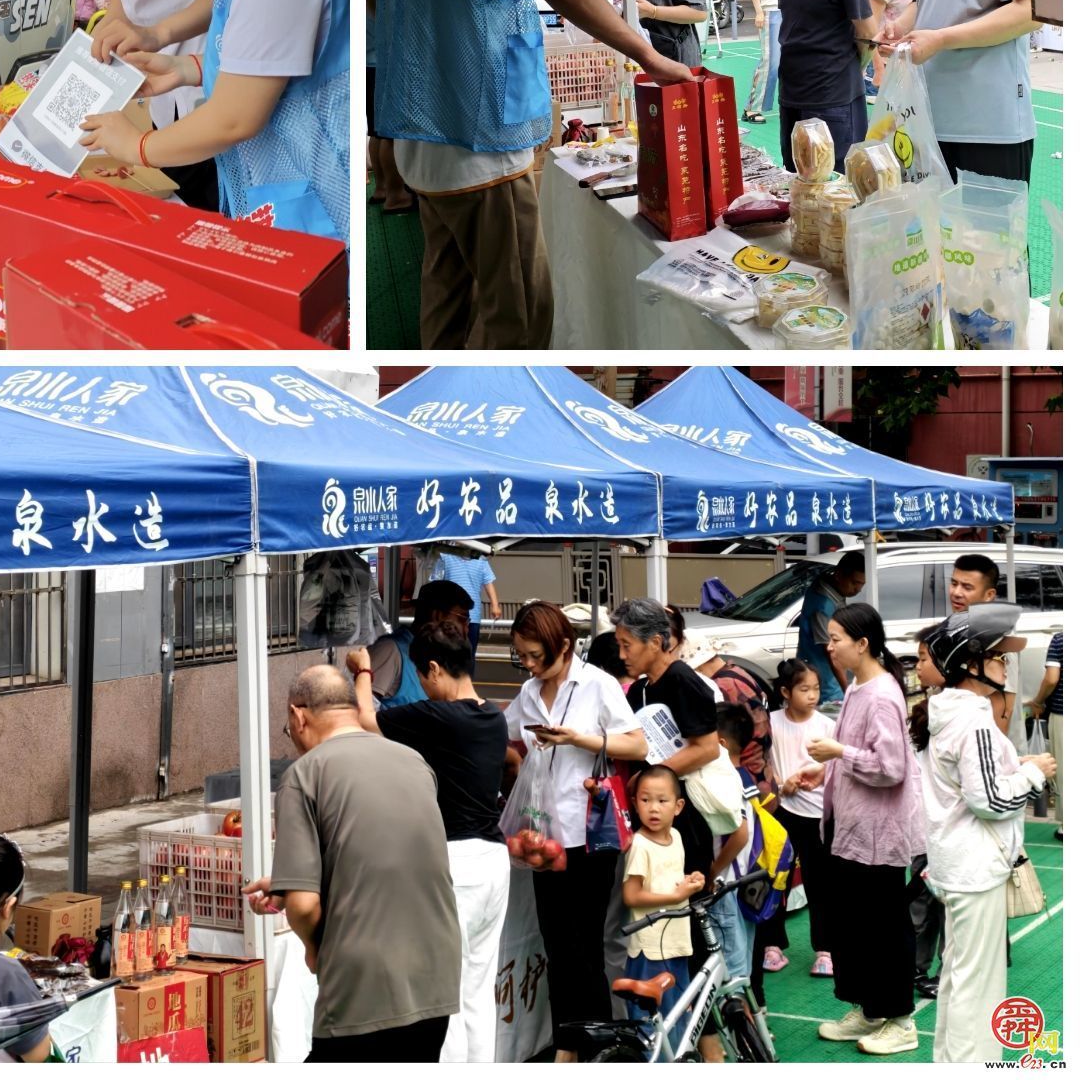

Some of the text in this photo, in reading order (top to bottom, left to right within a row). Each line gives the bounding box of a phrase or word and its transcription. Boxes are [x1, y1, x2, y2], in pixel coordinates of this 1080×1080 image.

[677, 124, 689, 162] 山东名吃
[58, 403, 91, 415] REN
[408, 400, 528, 425] 泉水人家
[464, 422, 490, 432] REN
[352, 475, 621, 530] 泉水人家 好农品 泉水造
[743, 490, 798, 529] 好农品
[811, 491, 854, 526] 泉水造
[923, 490, 964, 521] 好农品
[969, 494, 1004, 522] 泉水造
[11, 487, 171, 557] 泉水造
[690, 983, 718, 1047] PIGEON
